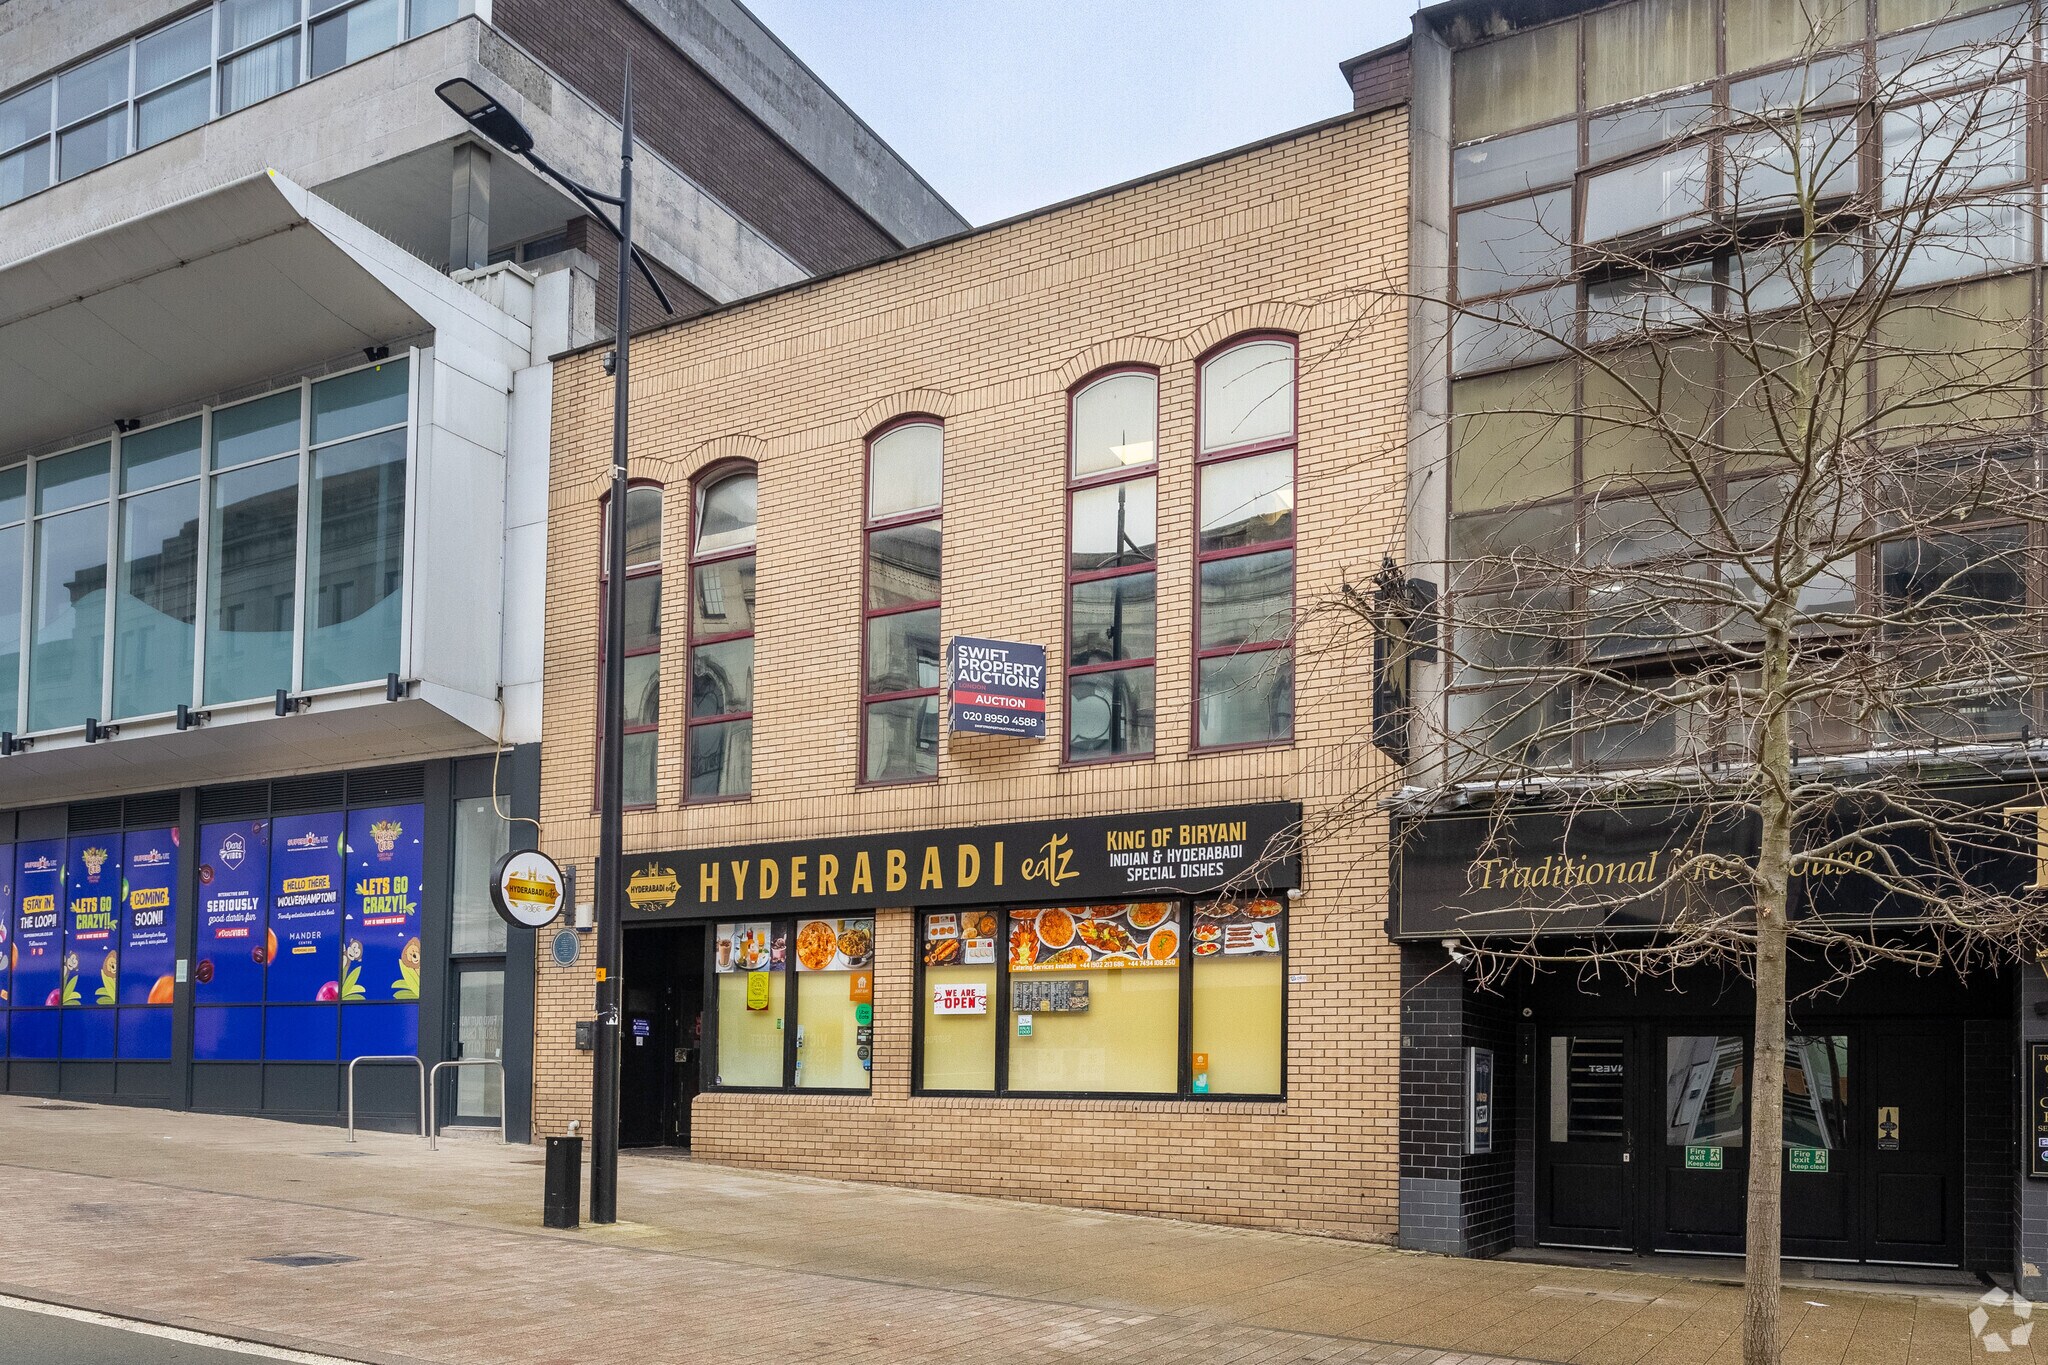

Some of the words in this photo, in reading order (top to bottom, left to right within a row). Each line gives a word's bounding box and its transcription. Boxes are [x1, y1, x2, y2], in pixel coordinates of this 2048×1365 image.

[958, 645, 1009, 662] SWIFT
[958, 658, 1042, 677] PROPERTY
[958, 670, 1040, 689] AUCTIONS
[959, 682, 986, 691] LONDON
[976, 695, 1026, 708] AUCTION
[963, 711, 982, 721] 020
[984, 712, 1010, 724] 8950
[1012, 716, 1037, 726] 4588
[1106, 830, 1146, 851] KING
[1152, 828, 1172, 848] OF
[1180, 820, 1247, 846] BIRYANI
[1110, 848, 1148, 867] INDIAN
[1152, 848, 1163, 863] &
[1166, 844, 1243, 864] HYDERABADI
[700, 841, 1004, 903] HYDERABADI
[1022, 832, 1080, 887] eatz
[1127, 864, 1176, 882] SPECIAL
[1180, 862, 1224, 878] DISHES
[1479, 850, 1658, 890] Traditional
[287, 880, 306, 890] HELLO
[308, 878, 326, 888] THERE
[363, 876, 390, 896] LETS
[394, 876, 408, 894] GO
[510, 885, 544, 896] HYDERABADI
[631, 884, 665, 894] HYDERABADI
[26, 900, 42, 910] STAY
[76, 898, 97, 913] LETS
[100, 897, 112, 912] GO
[207, 898, 259, 912] SERIOUSLY
[278, 892, 336, 908] WOLVERHAMPTON!!
[363, 894, 407, 914] CRAZY!!
[21, 916, 33, 928] THE
[35, 914, 56, 928] LOOP!!
[76, 913, 110, 930] CRAZY!!
[135, 910, 163, 926] SOON!!
[208, 914, 226, 926] good
[245, 912, 256, 922] fun
[290, 932, 322, 940] MANDER
[945, 998, 976, 1009] OPEN
